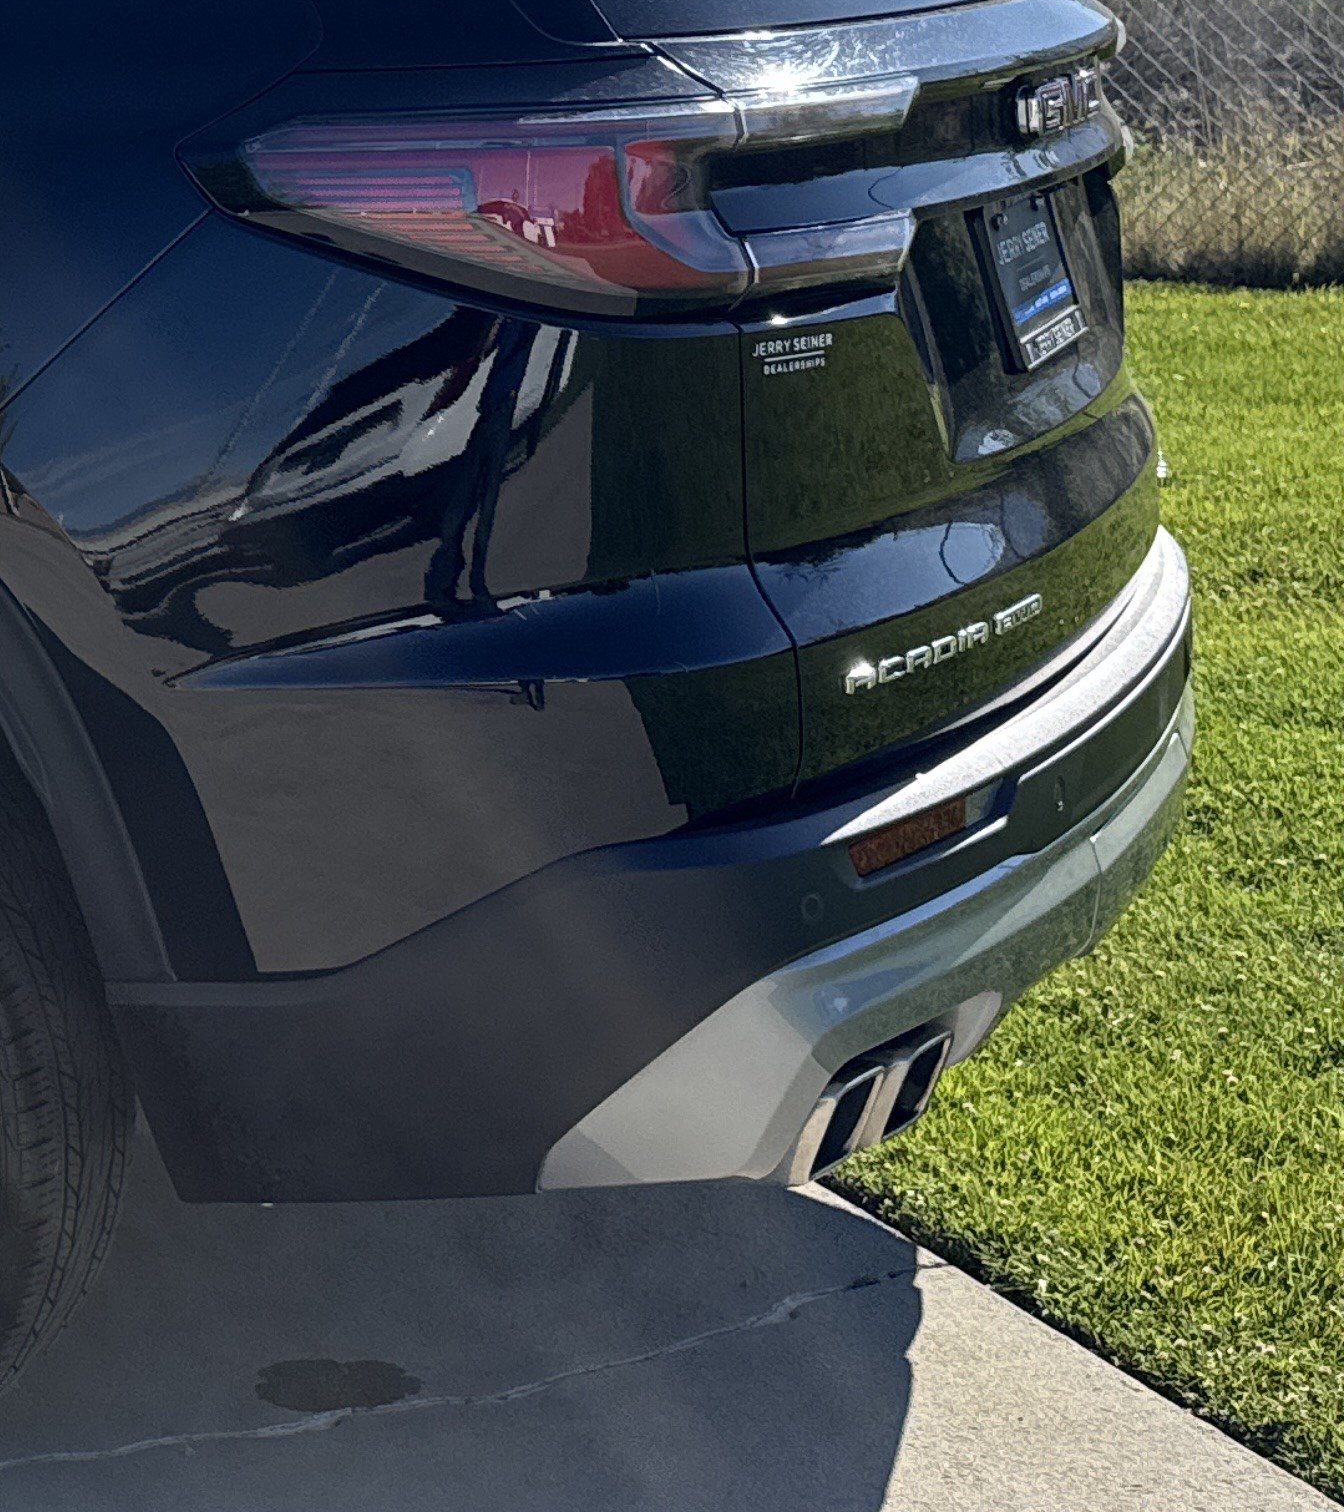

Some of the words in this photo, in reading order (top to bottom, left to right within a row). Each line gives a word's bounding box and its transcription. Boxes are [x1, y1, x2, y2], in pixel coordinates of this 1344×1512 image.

[752, 339, 791, 357] JERRY
[793, 333, 832, 351] SEINER
[763, 357, 825, 375] DEALERSHIPS
[845, 621, 989, 694] ACADIA
